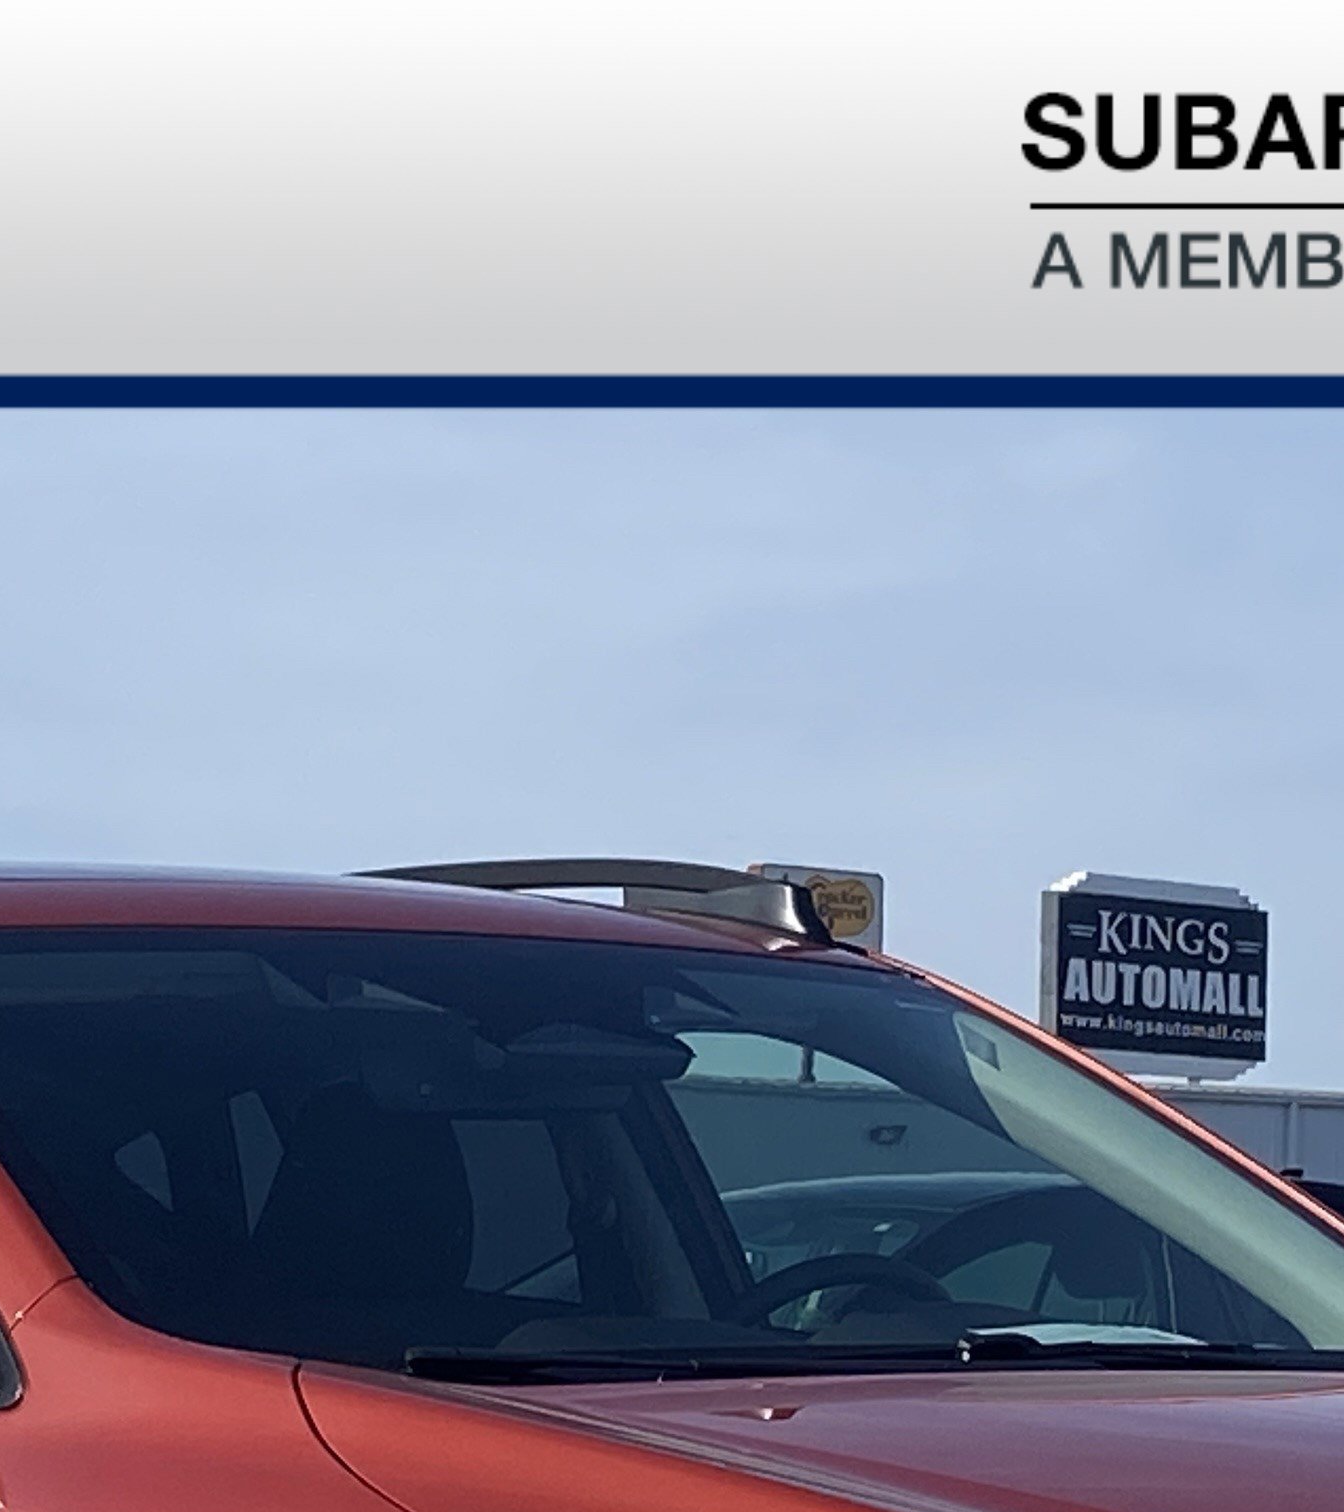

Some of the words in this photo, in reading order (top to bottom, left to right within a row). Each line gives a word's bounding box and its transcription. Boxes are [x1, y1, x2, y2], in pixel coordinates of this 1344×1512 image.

[1097, 909, 1230, 965] KINGS
[1062, 956, 1265, 1019] AUTOMALL
[1059, 1012, 1266, 1043] www.kingsautomall.com
